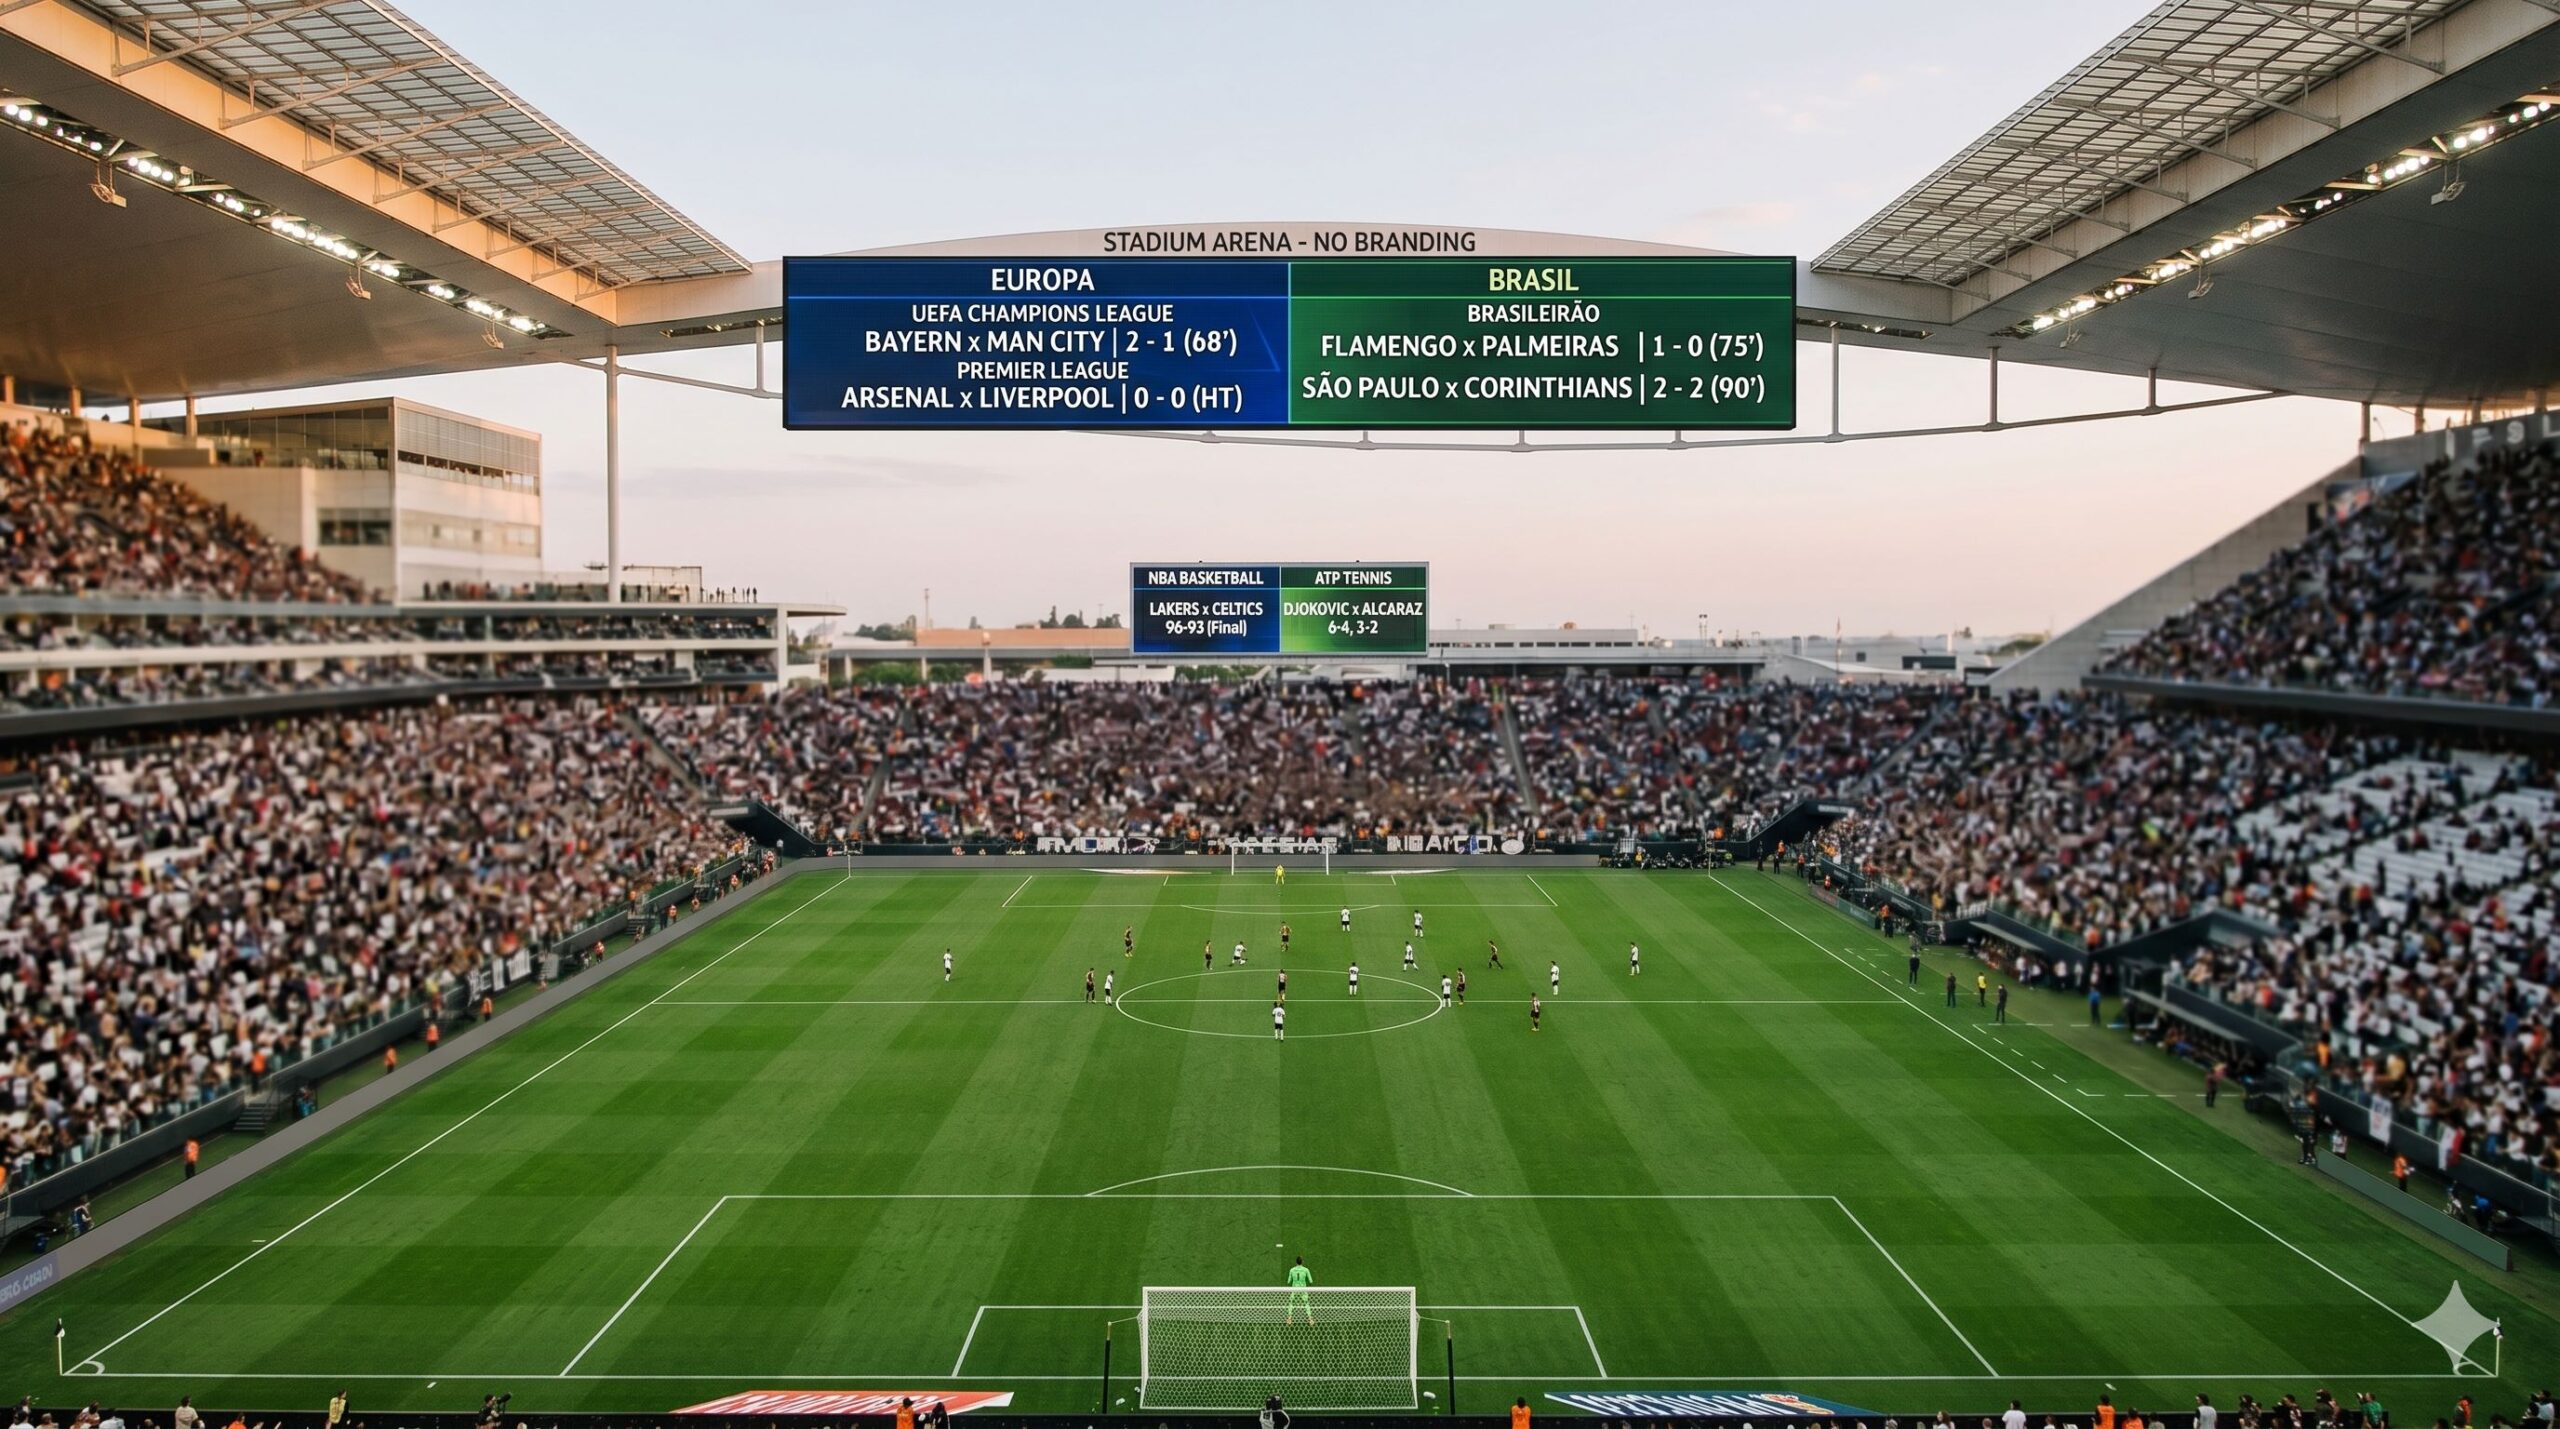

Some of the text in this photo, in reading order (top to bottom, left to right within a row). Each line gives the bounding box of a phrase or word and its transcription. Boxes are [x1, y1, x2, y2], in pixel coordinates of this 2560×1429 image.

[1103, 231, 1206, 252] STADIUM
[1212, 231, 1293, 252] ARENA
[1314, 231, 1348, 252] NO
[1355, 231, 1476, 252] BRANDING
[991, 268, 1095, 291] EUROPA
[1488, 268, 1580, 292] BRASIL
[912, 304, 1174, 323] UEFA CHAMPIONS LEAGUE
[1467, 300, 1600, 323] BRASILEIRÃO
[865, 330, 962, 353] BAYERN
[967, 336, 981, 353] x
[987, 330, 1044, 353] MAN
[1050, 330, 1105, 353] CITY
[1126, 330, 1139, 353] 2
[1163, 330, 1175, 353] 1
[1321, 334, 1457, 358] FLAMENGO
[1462, 340, 1476, 358] x
[1482, 334, 1619, 358] PALMEIRAS
[1653, 335, 1665, 357] 1
[1688, 334, 1703, 357] 0
[957, 361, 1129, 380] PREMIER LEAGUE
[1302, 370, 1352, 399] SÃO
[1358, 376, 1440, 399] PAULO
[1445, 381, 1459, 399] x
[1464, 376, 1633, 399] CORINTHIANS
[1653, 376, 1667, 399] 2
[1689, 376, 1703, 399] 2
[841, 386, 954, 409] ARSENAL
[959, 391, 974, 409] x
[980, 386, 1115, 409] LIVERPOOL
[1134, 386, 1149, 409] 0
[1170, 386, 1186, 409] 0
[1192, 384, 1243, 414] (HT)
[1148, 570, 1264, 585] NBA BASKETBALL
[1314, 570, 1393, 585] ATP TENNIS
[1149, 601, 1264, 616] LAKERS x CELTICS
[1283, 601, 1423, 616] DJOKOVIC x ALCARAZ
[1165, 619, 1248, 638] 96-93 (Final)
[1327, 620, 1379, 637] 6-4, 3-2
